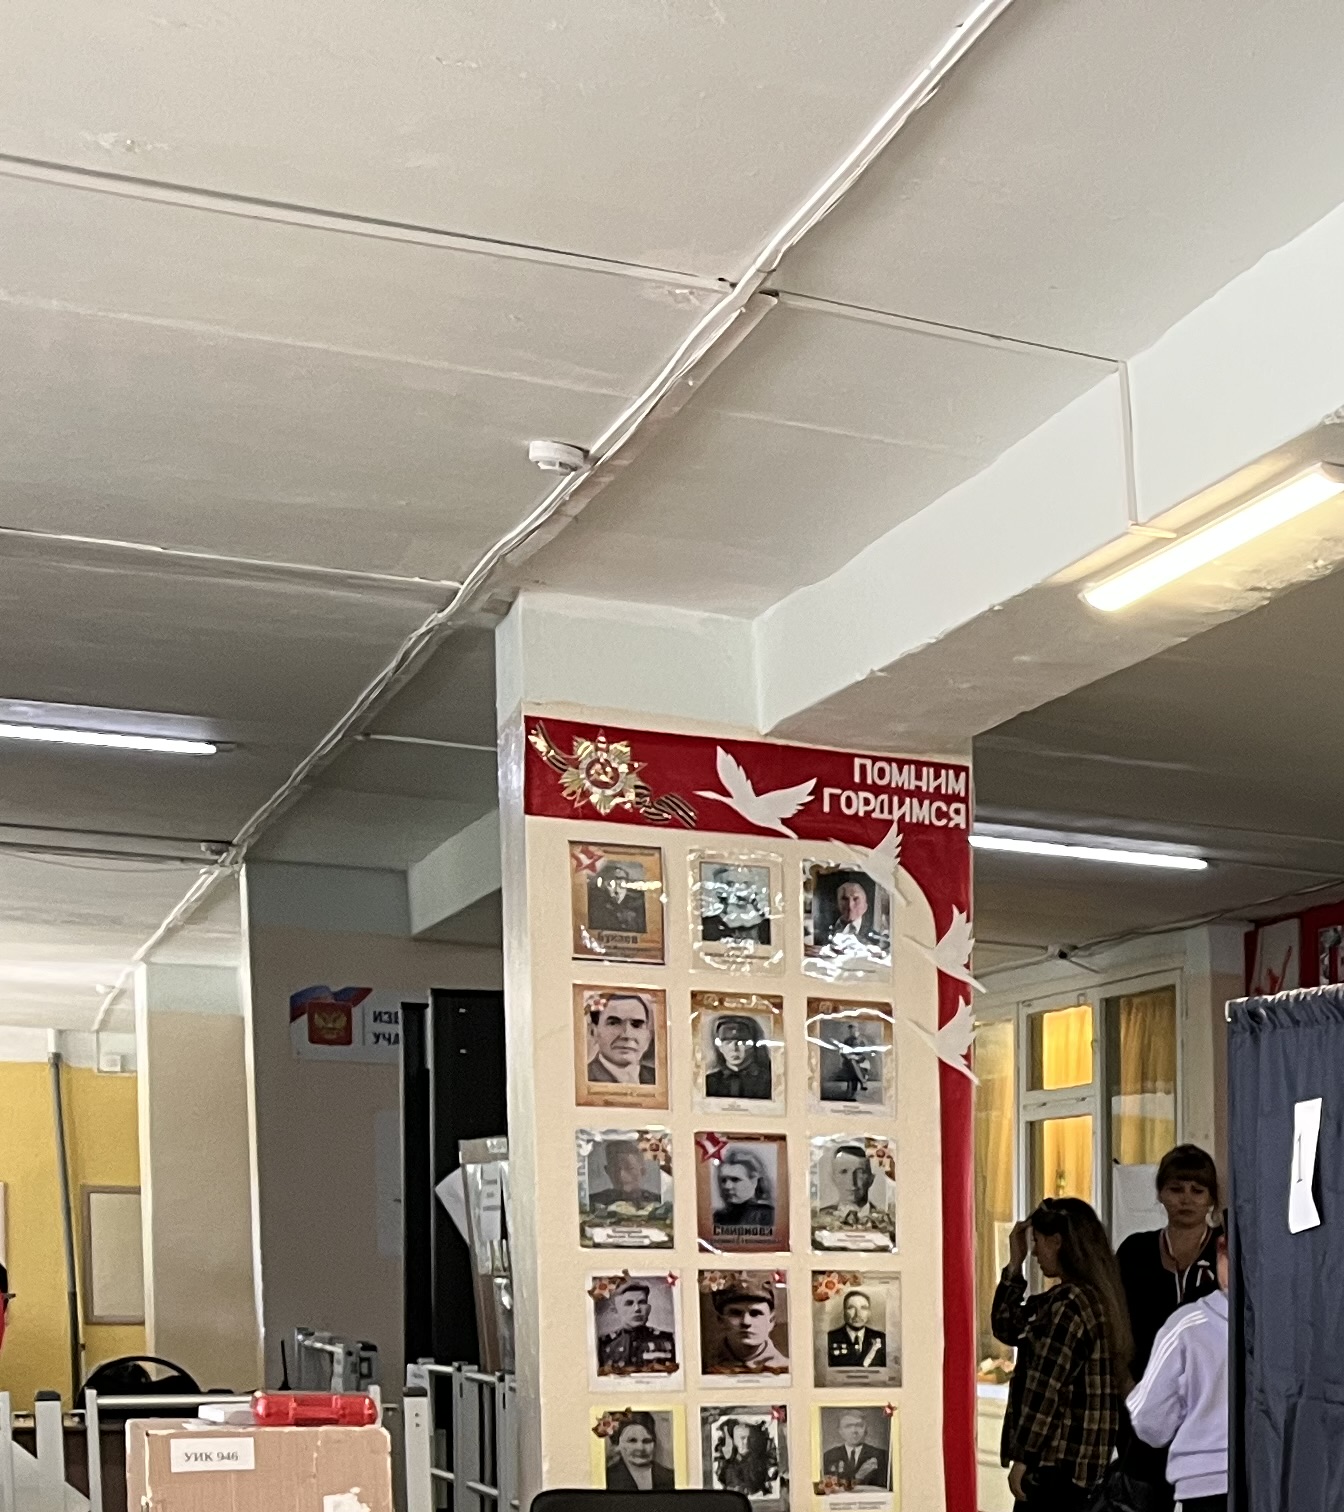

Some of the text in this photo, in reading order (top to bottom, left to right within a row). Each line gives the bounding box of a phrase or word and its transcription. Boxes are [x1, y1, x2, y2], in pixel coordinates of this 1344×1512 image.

[854, 757, 967, 798] ПОМНИМ
[822, 787, 967, 830] ГОРДИМСЯ
[1296, 1133, 1303, 1183] 1
[184, 1450, 239, 1463] УИК 946
